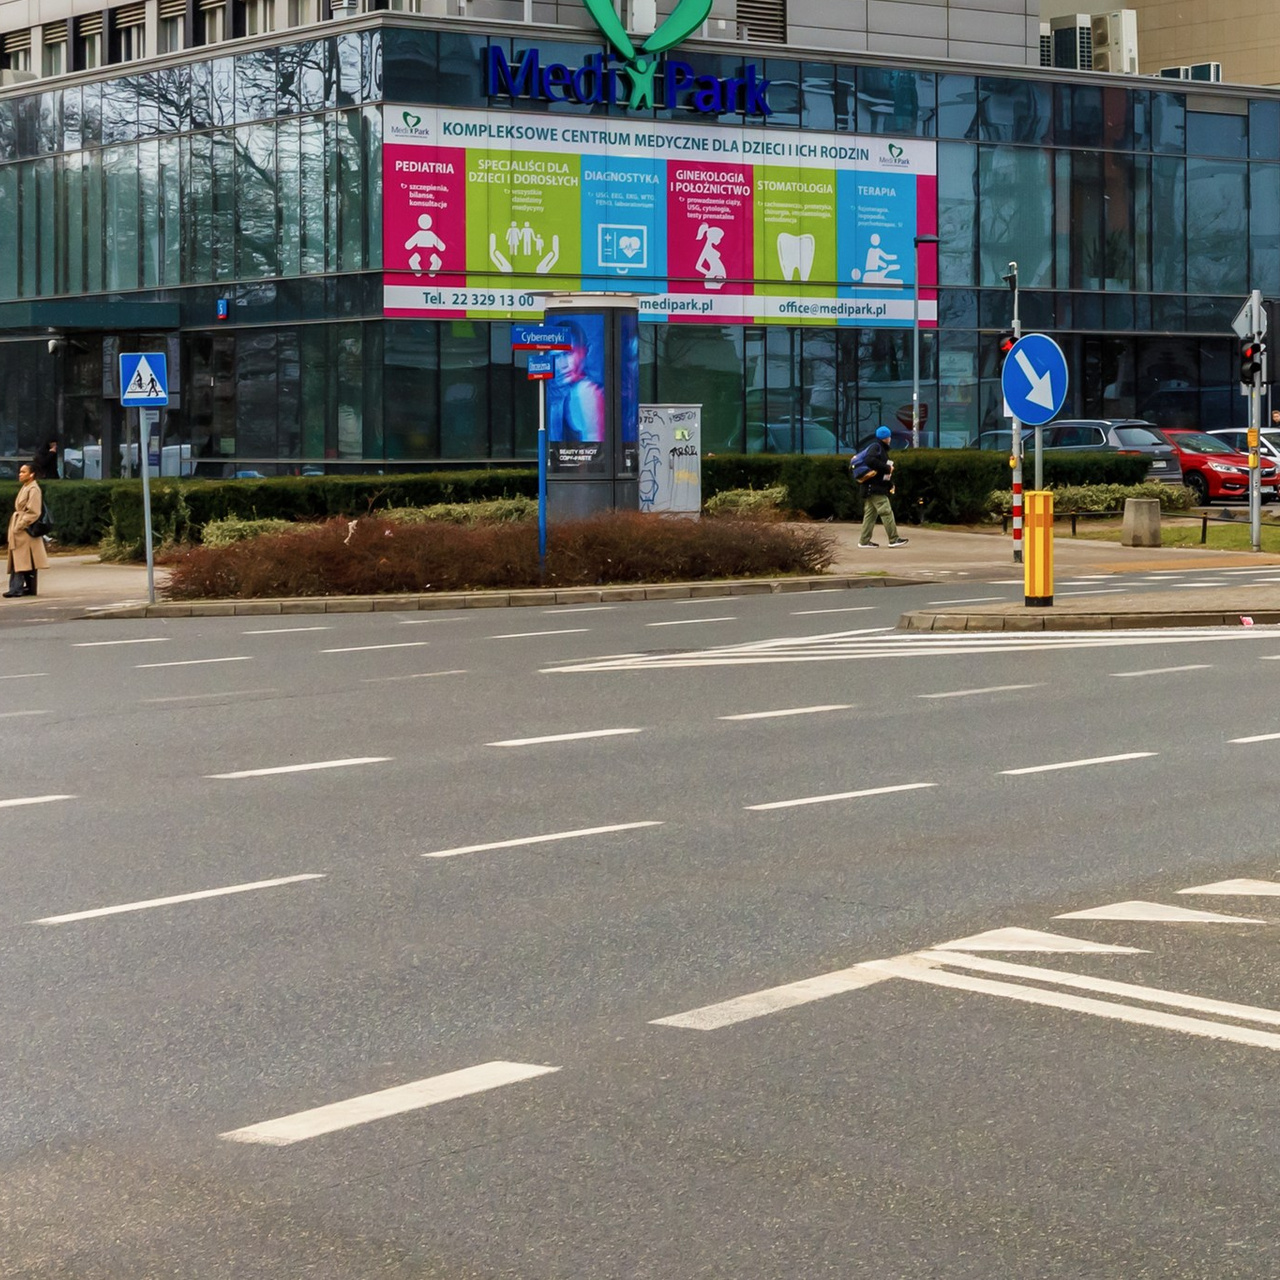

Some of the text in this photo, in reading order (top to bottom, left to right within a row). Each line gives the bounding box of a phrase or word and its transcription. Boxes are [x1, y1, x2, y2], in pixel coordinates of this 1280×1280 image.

[486, 45, 773, 116] Medi Park
[443, 122, 869, 160] KOMPLEKSOWE CENTRUM MEDYCZNE DLA DZIECI I ICH RODZIN
[395, 160, 454, 174] PEDIATRIA
[478, 160, 570, 174] SPECJALIŚCI DLA
[468, 172, 578, 186] DZIECI I DOROSŁYCH
[584, 170, 660, 184] DIAGNOSTYKA
[676, 170, 745, 183] GINEKOLOGIA
[670, 182, 751, 196] I POŁOŻNICTWO
[757, 180, 833, 194] STOMATOLOGIA
[858, 186, 896, 197] TERAPIA
[409, 200, 448, 210] konsultacje
[422, 292, 534, 306] Tel. 22 329 13 00
[778, 301, 886, 317] office@medipark.pl
[522, 332, 565, 344] Cybernetyki
